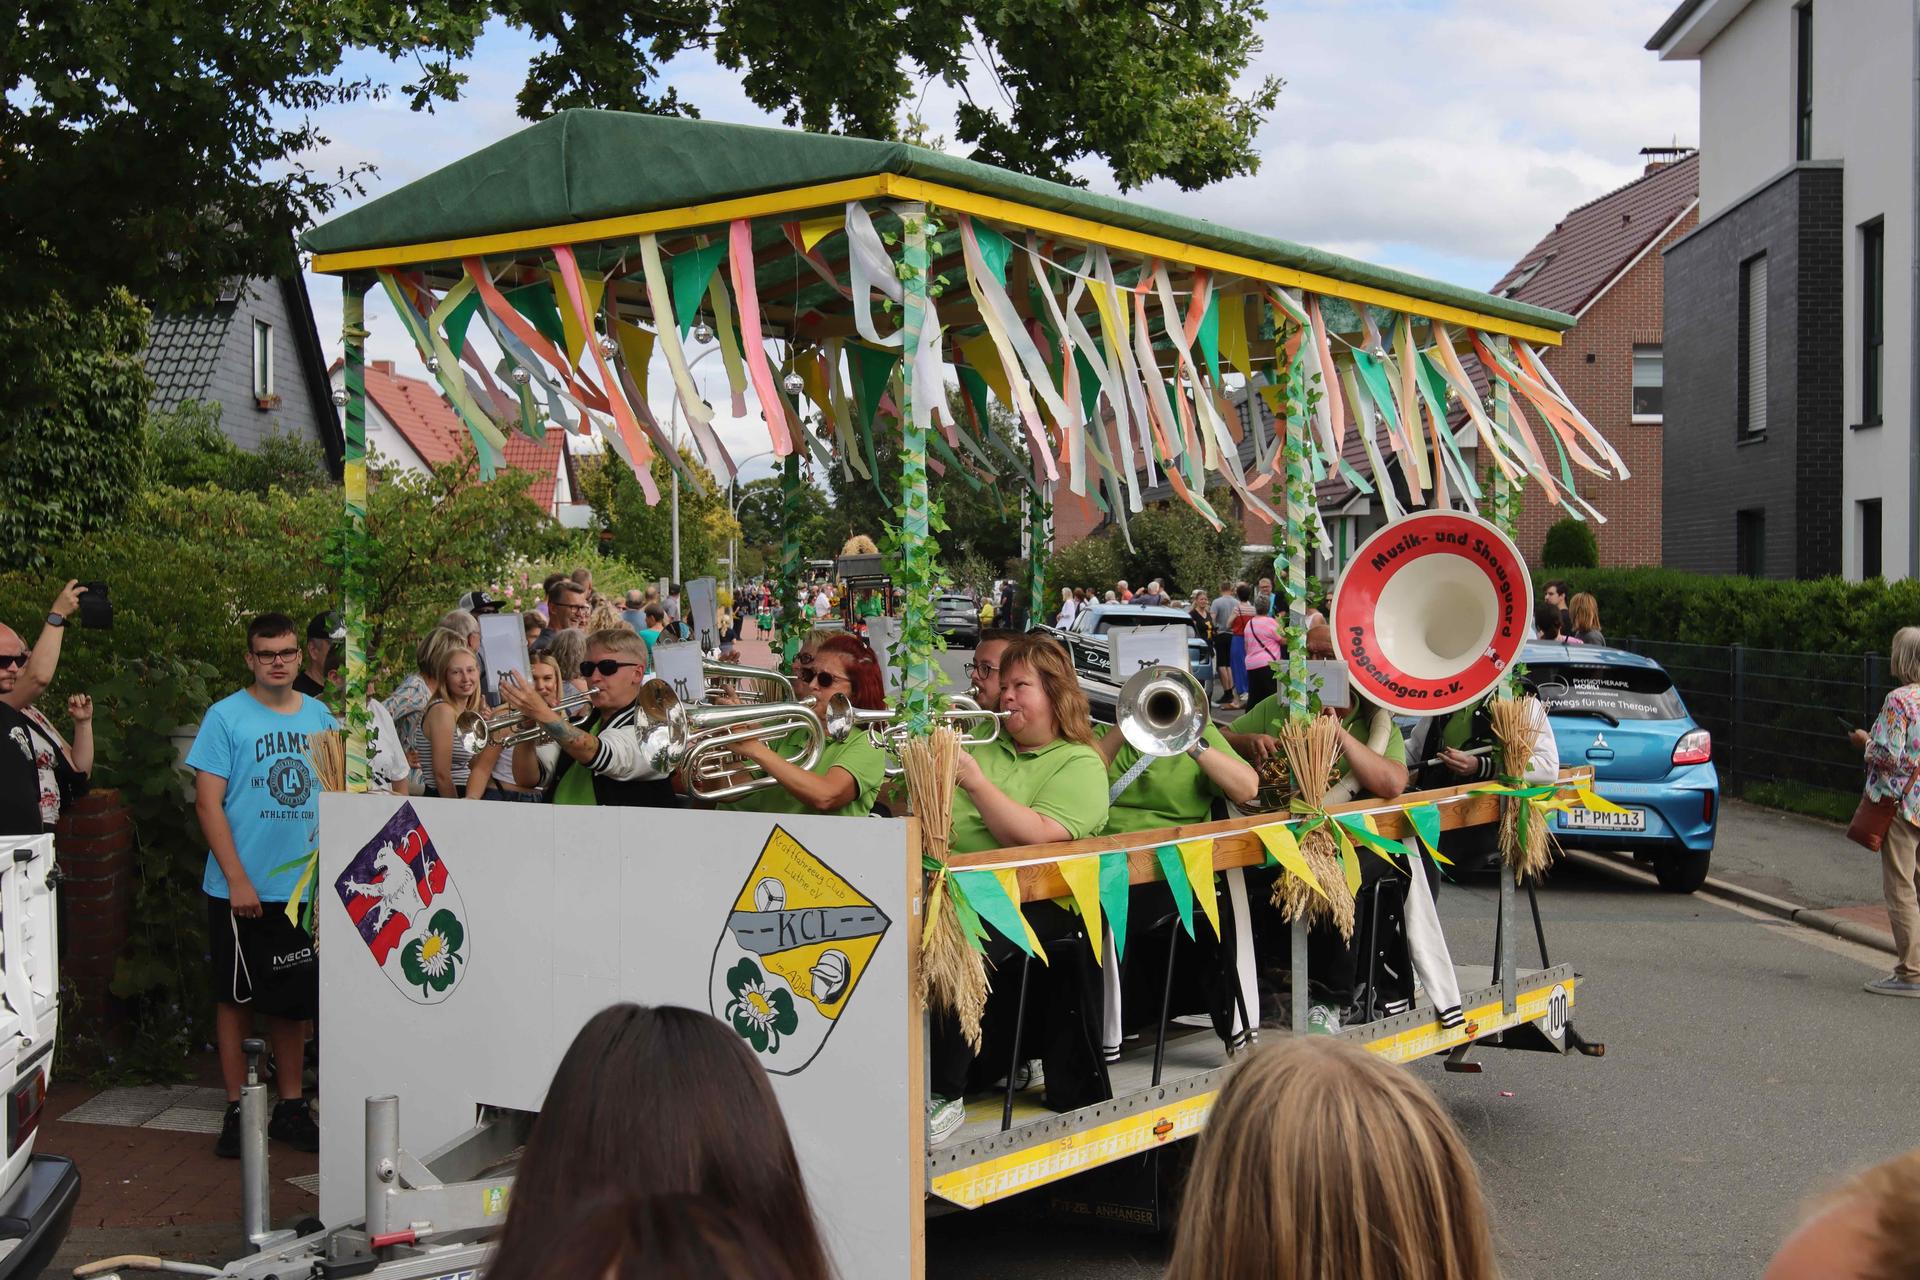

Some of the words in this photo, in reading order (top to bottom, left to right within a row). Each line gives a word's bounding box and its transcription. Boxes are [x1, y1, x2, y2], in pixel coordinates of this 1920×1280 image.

[1371, 533, 1428, 572] Musik-
[1435, 532, 1468, 546] und
[1472, 538, 1513, 638] Showguard
[1349, 625, 1428, 699] Poggenhagen
[1432, 681, 1464, 698] e.V.
[1582, 698, 1596, 707] für
[1598, 699, 1617, 708] Ihre
[1619, 700, 1658, 713] Therapie
[251, 778, 264, 787] INT
[260, 810, 298, 819] ATHLETIC
[1574, 809, 1584, 824] H
[825, 877, 846, 899] Club
[777, 909, 837, 947] KCL
[273, 947, 312, 965] IVECO
[1549, 993, 1566, 1032] 100
